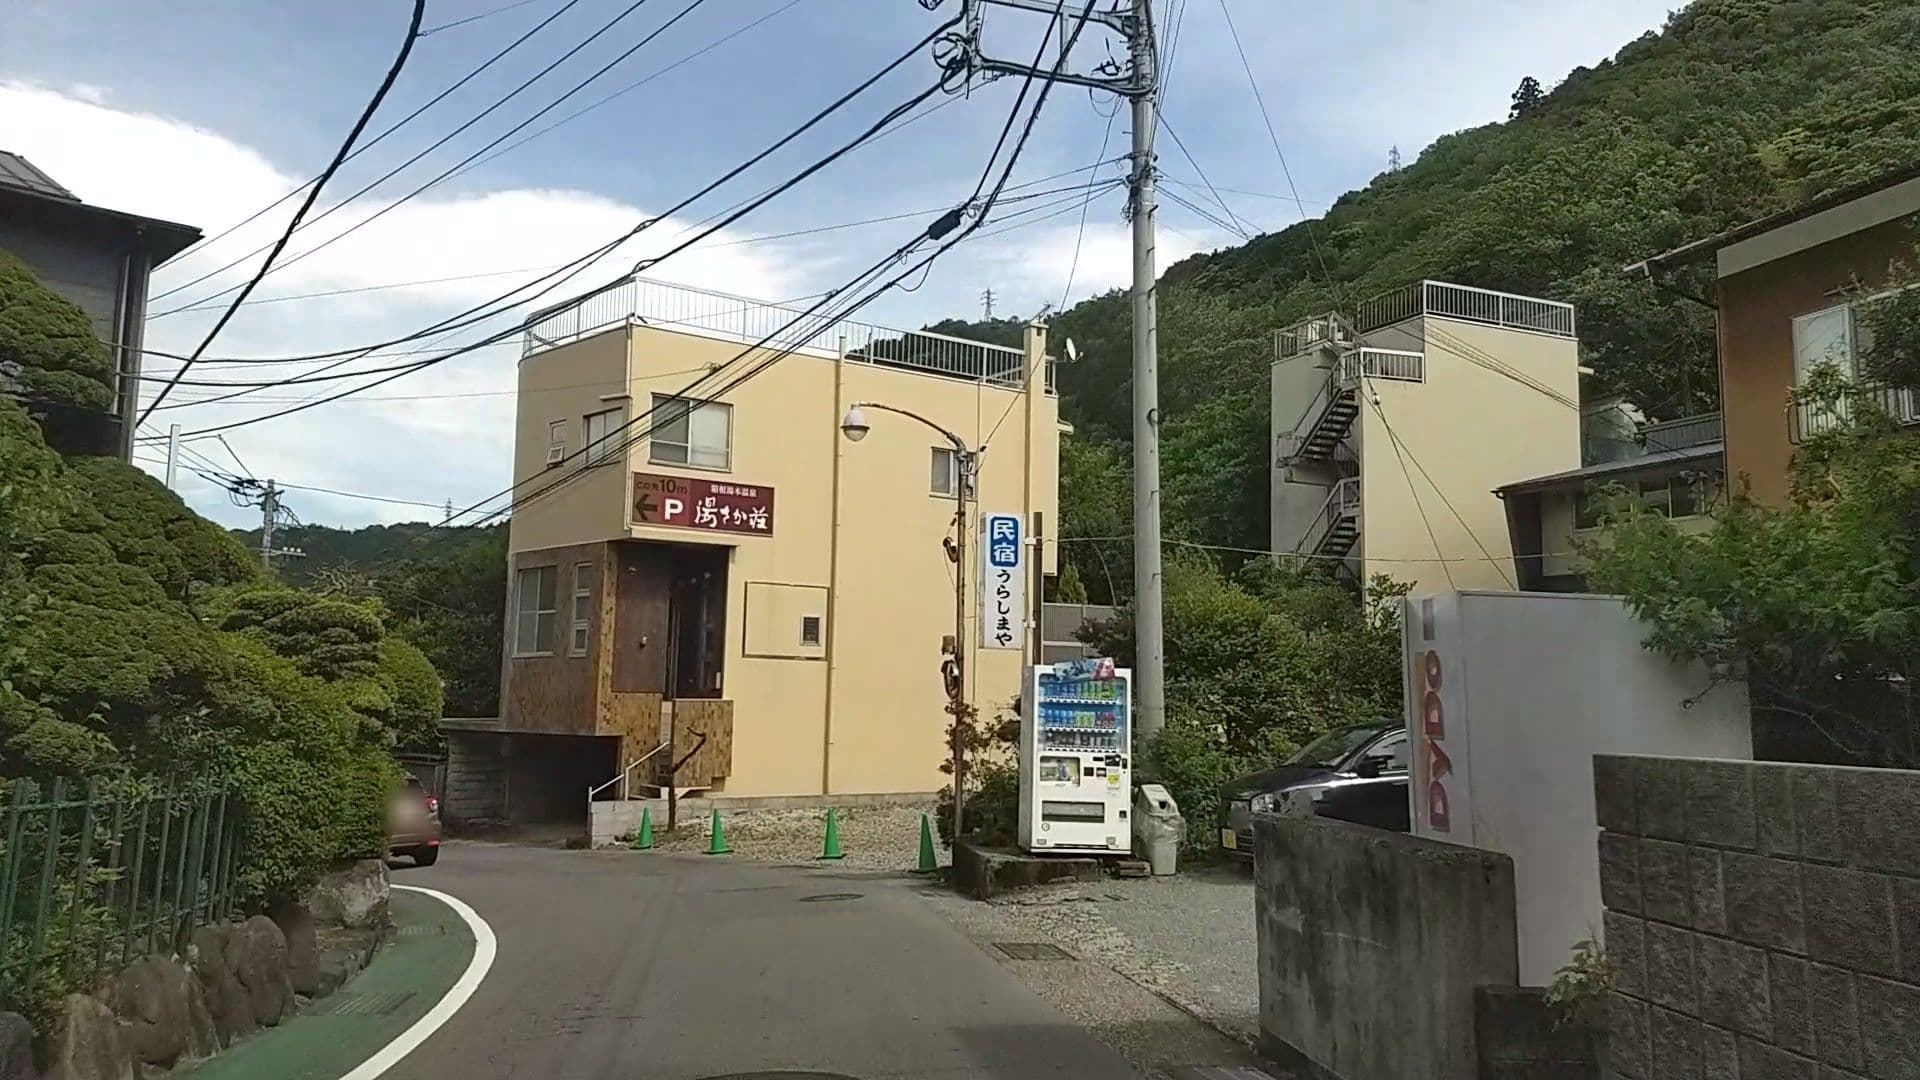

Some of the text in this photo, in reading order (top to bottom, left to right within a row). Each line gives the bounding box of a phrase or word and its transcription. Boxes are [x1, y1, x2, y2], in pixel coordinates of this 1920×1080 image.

[664, 498, 684, 520] P
[993, 519, 1016, 563] 民宿
[995, 569, 1013, 647] うらしまや
